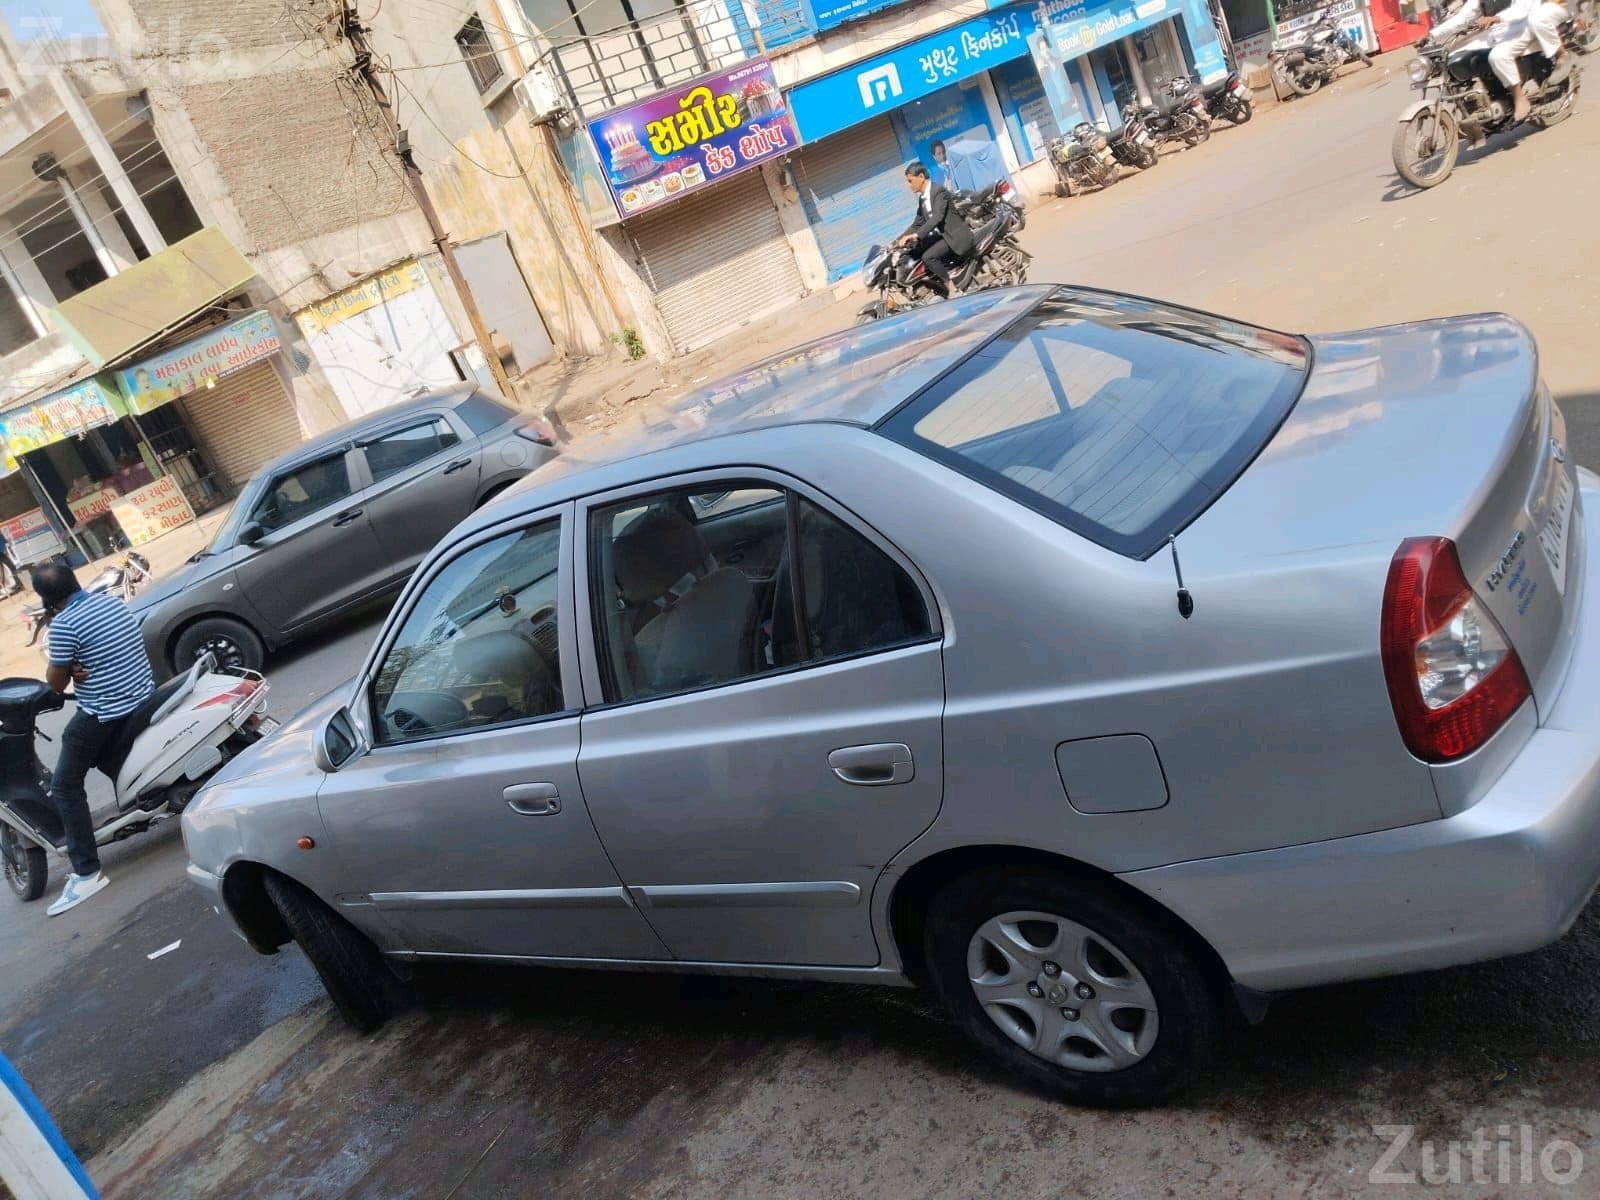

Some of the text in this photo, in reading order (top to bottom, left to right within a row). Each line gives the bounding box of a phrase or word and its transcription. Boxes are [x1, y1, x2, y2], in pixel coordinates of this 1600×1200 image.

[1056, 33, 1080, 51] Book
[1095, 14, 1118, 35] Gold
[919, 45, 958, 83] મુથૂટ
[646, 86, 742, 156] સમીર
[700, 124, 787, 175] કેક શોપ
